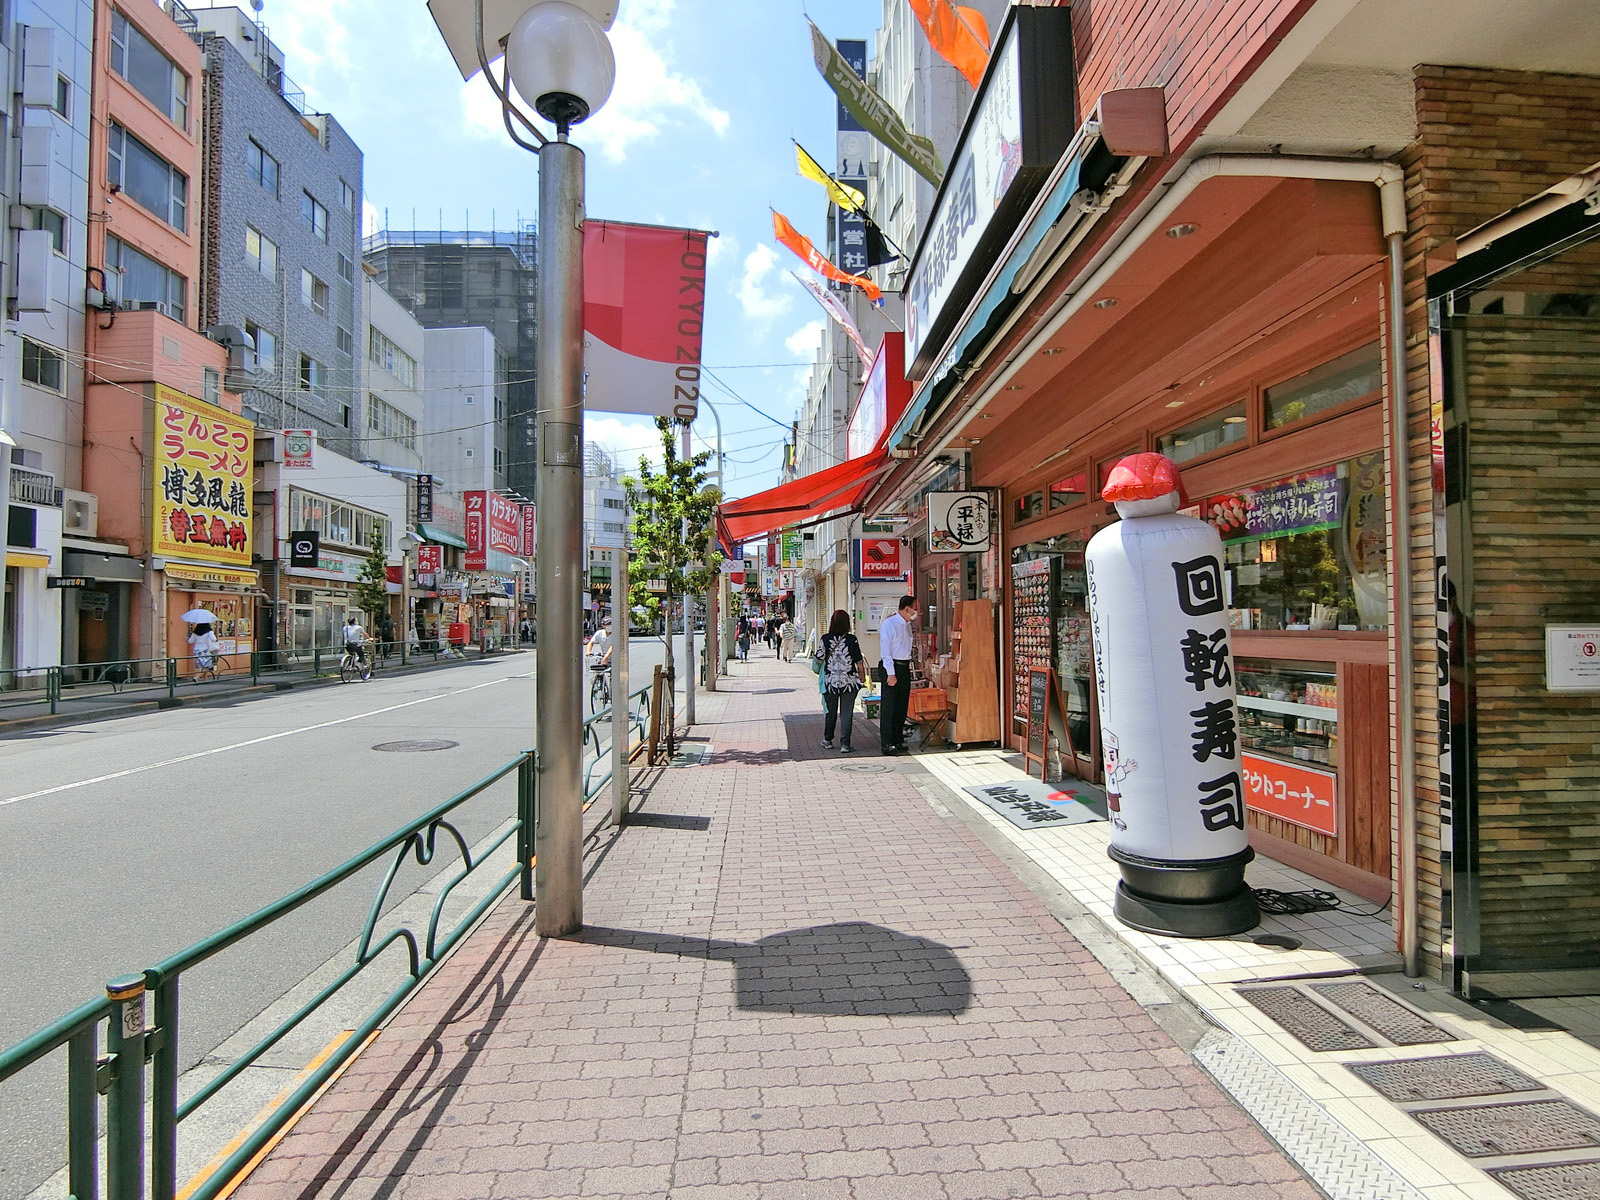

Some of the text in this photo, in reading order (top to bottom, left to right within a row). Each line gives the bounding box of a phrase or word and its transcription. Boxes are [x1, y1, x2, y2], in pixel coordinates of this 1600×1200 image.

[922, 152, 977, 316] 平禄寿司
[677, 233, 706, 337] TOKYO
[674, 345, 702, 419] 2020
[163, 404, 249, 452] とんこつ
[288, 443, 308, 452] 100
[163, 435, 249, 478] ラーメン
[161, 463, 249, 518] 博多風龍
[491, 498, 517, 524] カラオケ
[1245, 491, 1338, 530] お持ち帰り寿司
[169, 508, 247, 552] 替玉無料
[957, 506, 974, 540] 平禄
[419, 548, 431, 570] 焼肉
[864, 562, 898, 570] KYODAI
[1171, 555, 1244, 831] 回転寿司
